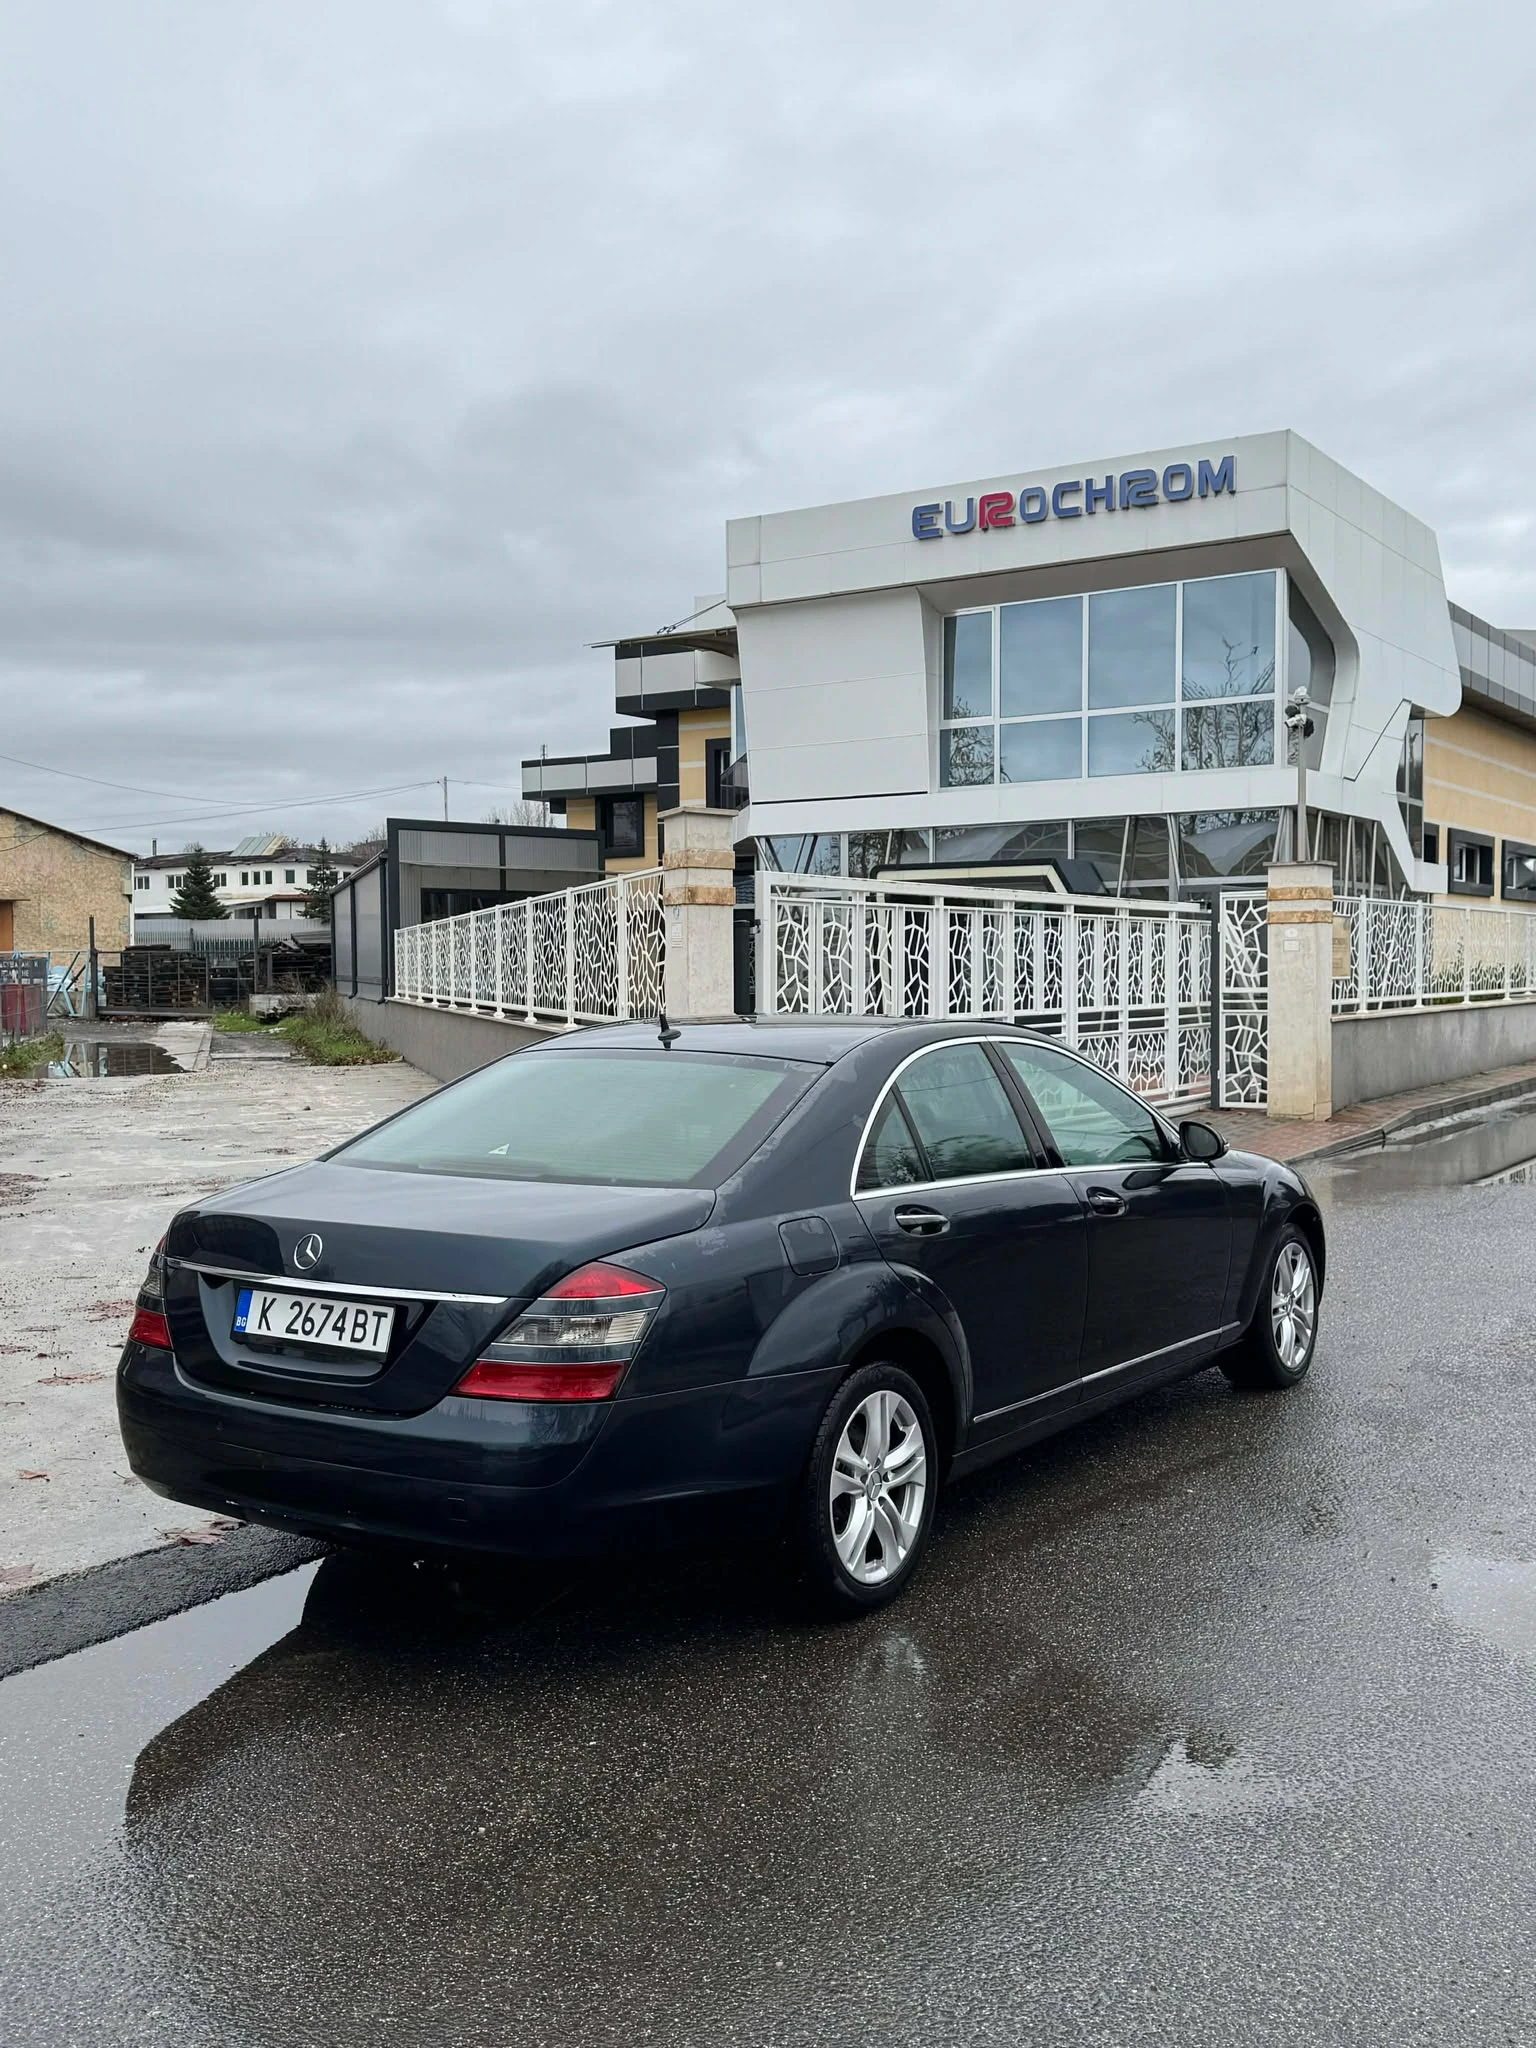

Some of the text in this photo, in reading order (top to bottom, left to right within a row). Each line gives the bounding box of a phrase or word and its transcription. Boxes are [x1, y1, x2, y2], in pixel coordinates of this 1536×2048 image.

[912, 455, 1237, 540] EUROCHROM
[236, 1316, 247, 1327] BG
[257, 1296, 388, 1346] K 2674BT
